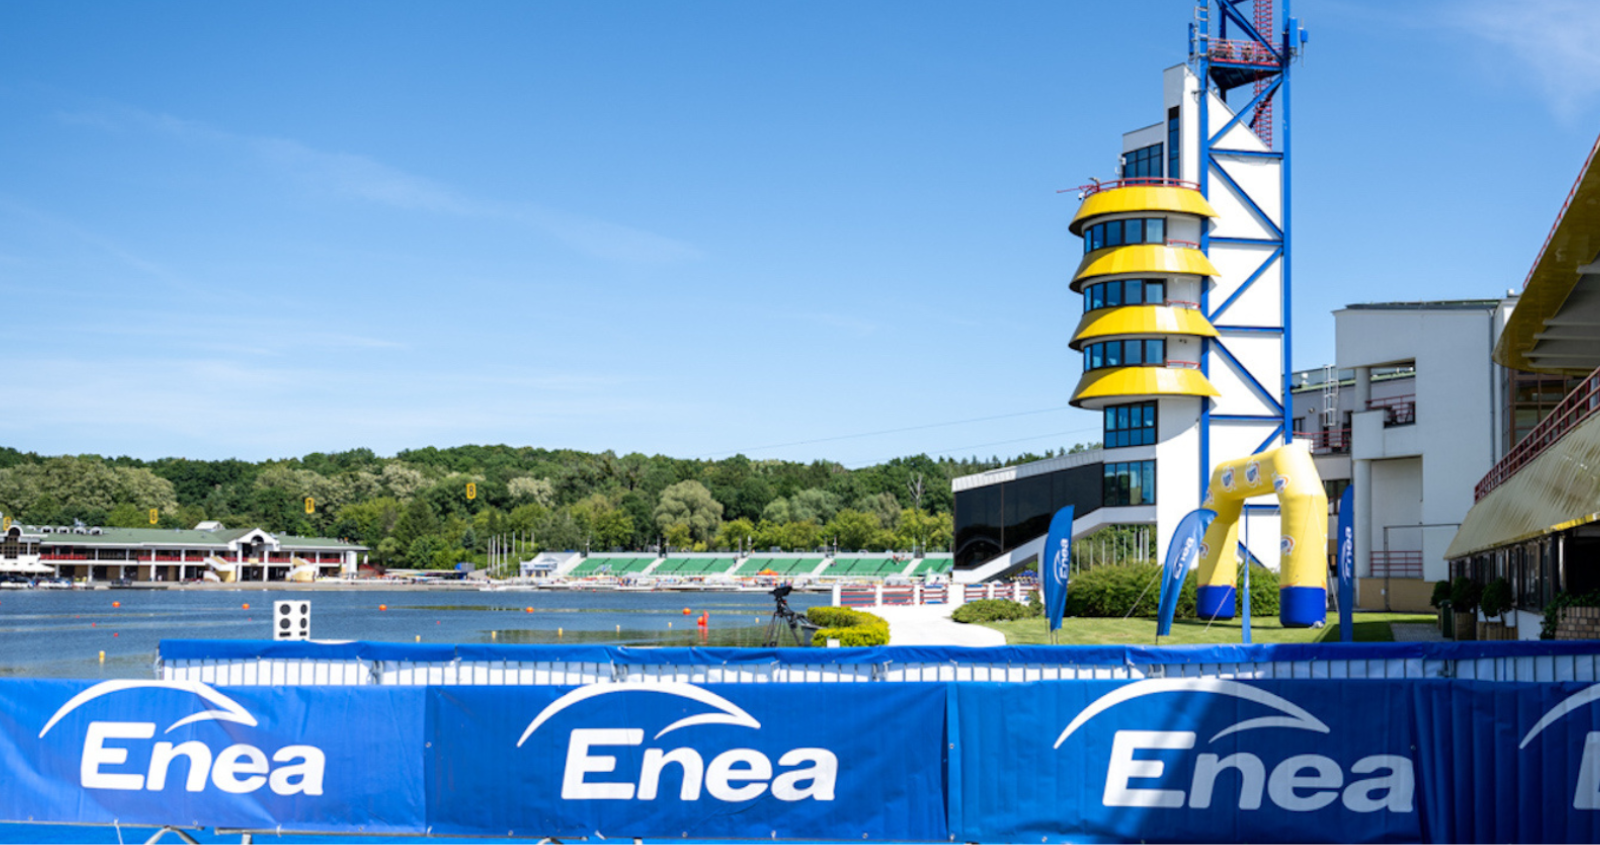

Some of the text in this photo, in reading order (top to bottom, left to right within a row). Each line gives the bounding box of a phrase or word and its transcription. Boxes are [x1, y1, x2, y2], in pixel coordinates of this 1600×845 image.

[1060, 538, 1069, 579] Enea
[80, 721, 325, 797] Enea
[561, 728, 838, 803] Enea
[1102, 730, 1415, 813] Enea
